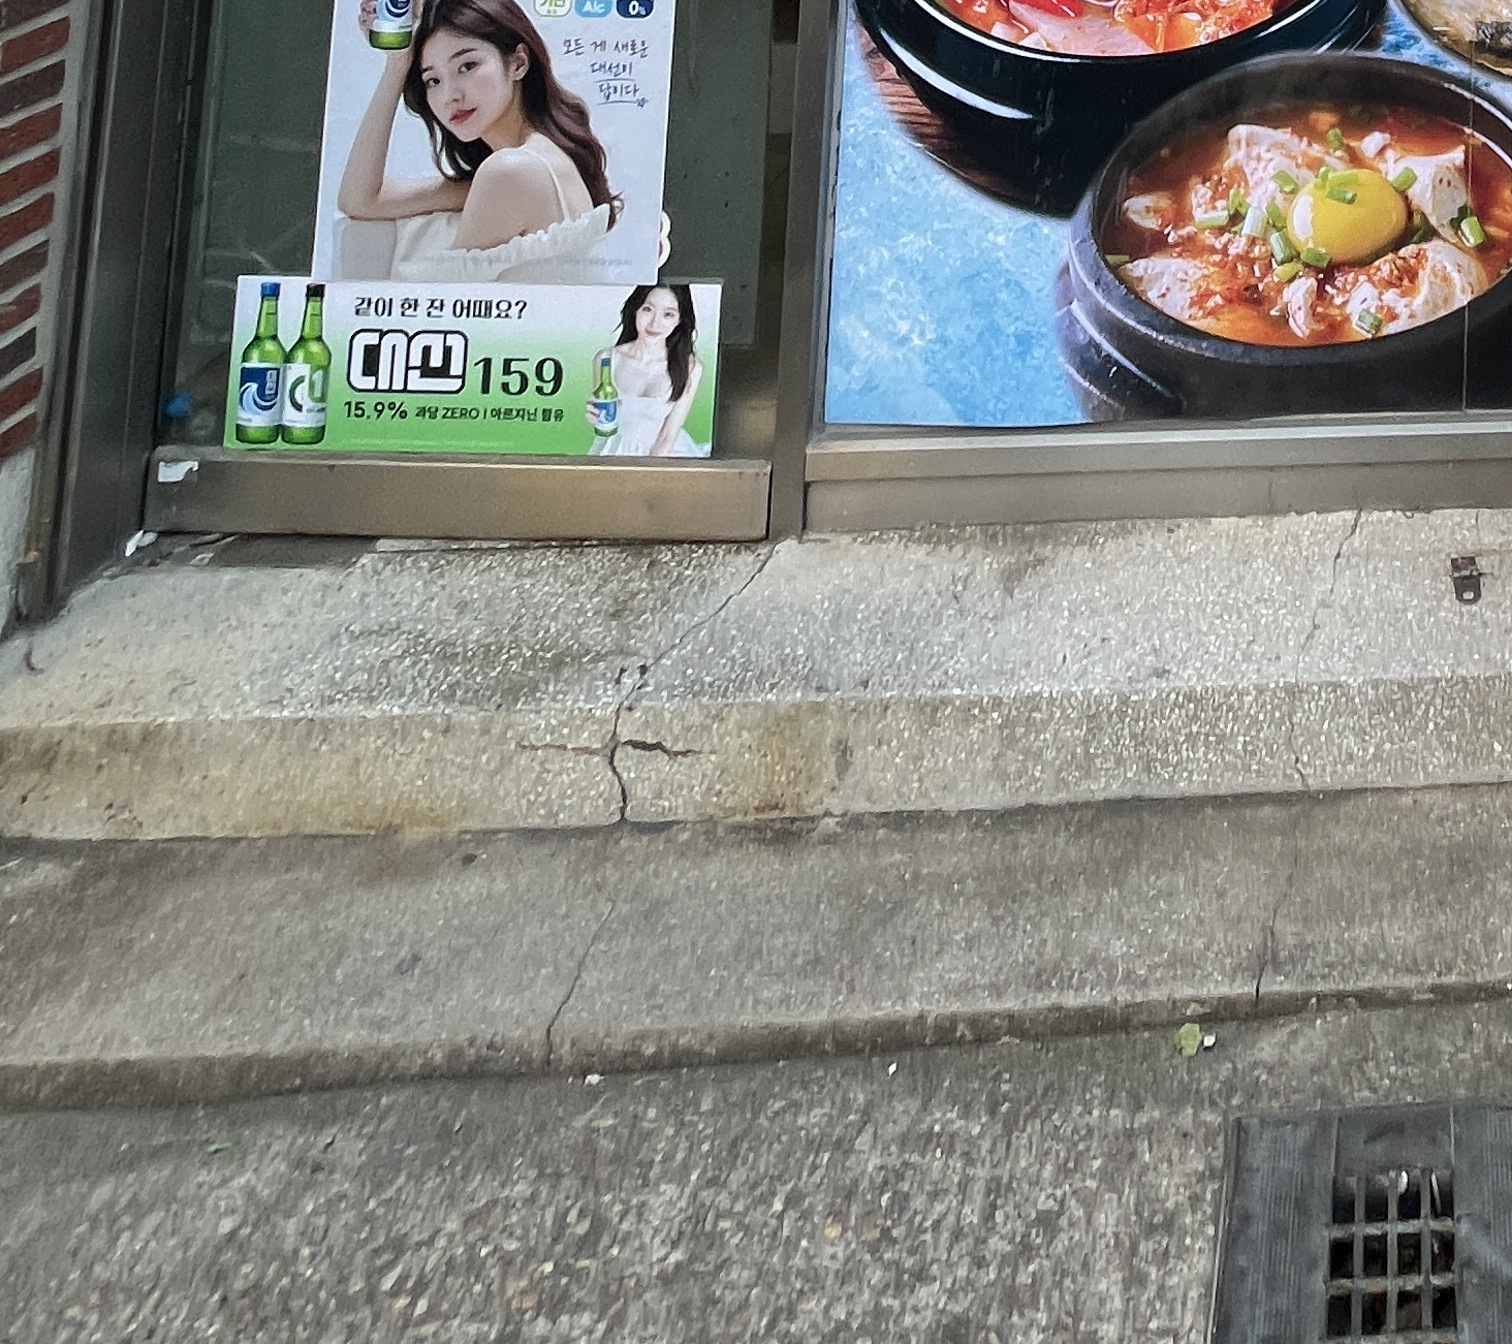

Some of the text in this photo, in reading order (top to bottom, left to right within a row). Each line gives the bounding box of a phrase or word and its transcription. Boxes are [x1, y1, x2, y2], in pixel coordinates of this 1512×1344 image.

[628, 0, 647, 15] 0%
[563, 38, 585, 56] 모든
[613, 39, 649, 59] 새로운
[598, 82, 640, 101] 답이다
[354, 296, 394, 317] 같이
[400, 297, 419, 318] 한
[452, 298, 528, 320] 어때요?
[347, 328, 564, 396] 대선 159
[343, 401, 408, 422] 15.9%
[442, 407, 480, 420] ZERO
